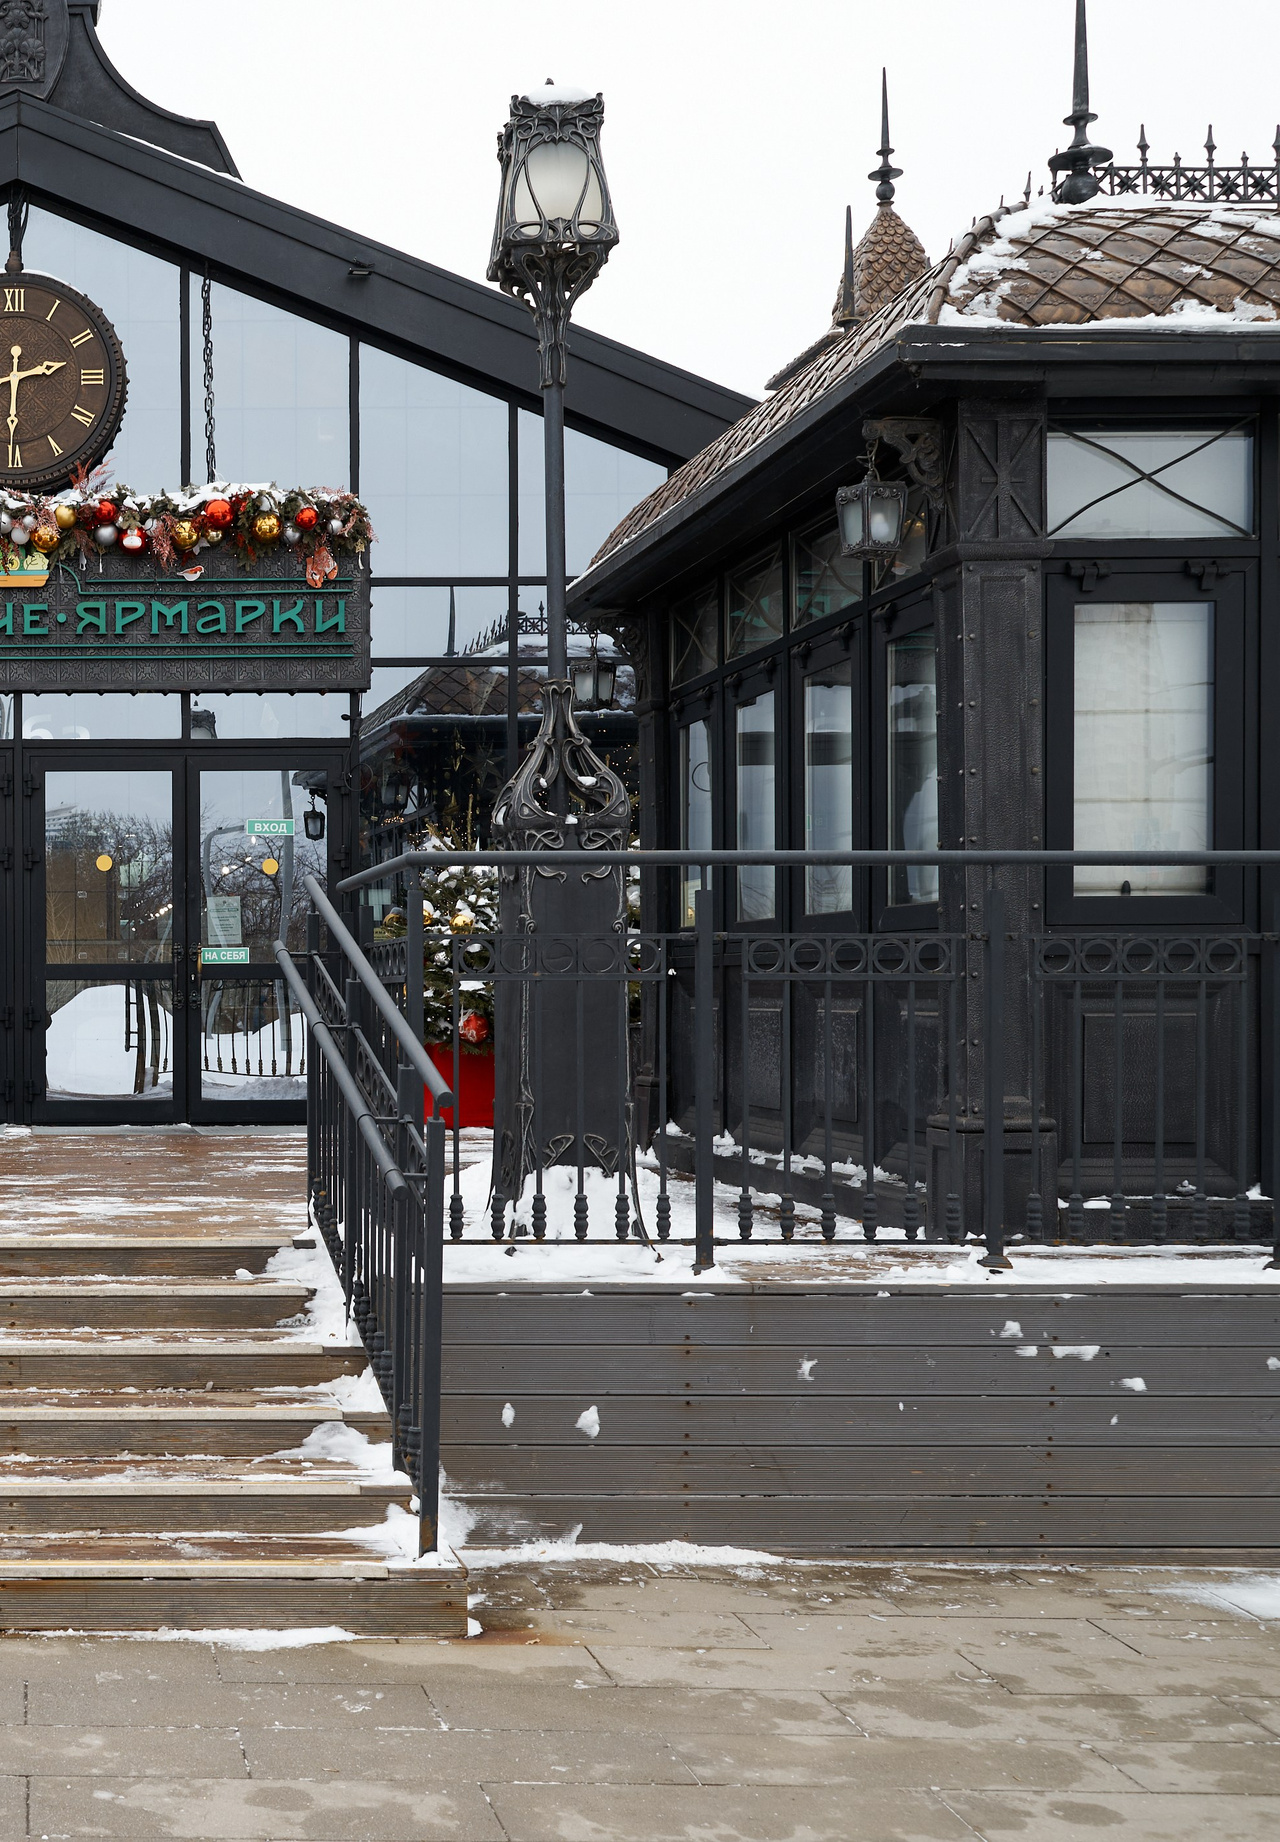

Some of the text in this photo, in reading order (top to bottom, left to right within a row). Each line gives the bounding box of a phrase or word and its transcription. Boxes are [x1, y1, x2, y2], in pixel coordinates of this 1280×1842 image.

[3, 288, 25, 312] XII
[45, 299, 61, 322] I
[69, 328, 94, 349] II
[80, 368, 104, 386] III
[70, 404, 96, 428] IV
[7, 444, 23, 468] VI
[47, 434, 64, 457] V
[254, 823, 287, 833] ВХОД
[205, 951, 246, 960] НА СЕБЯ
